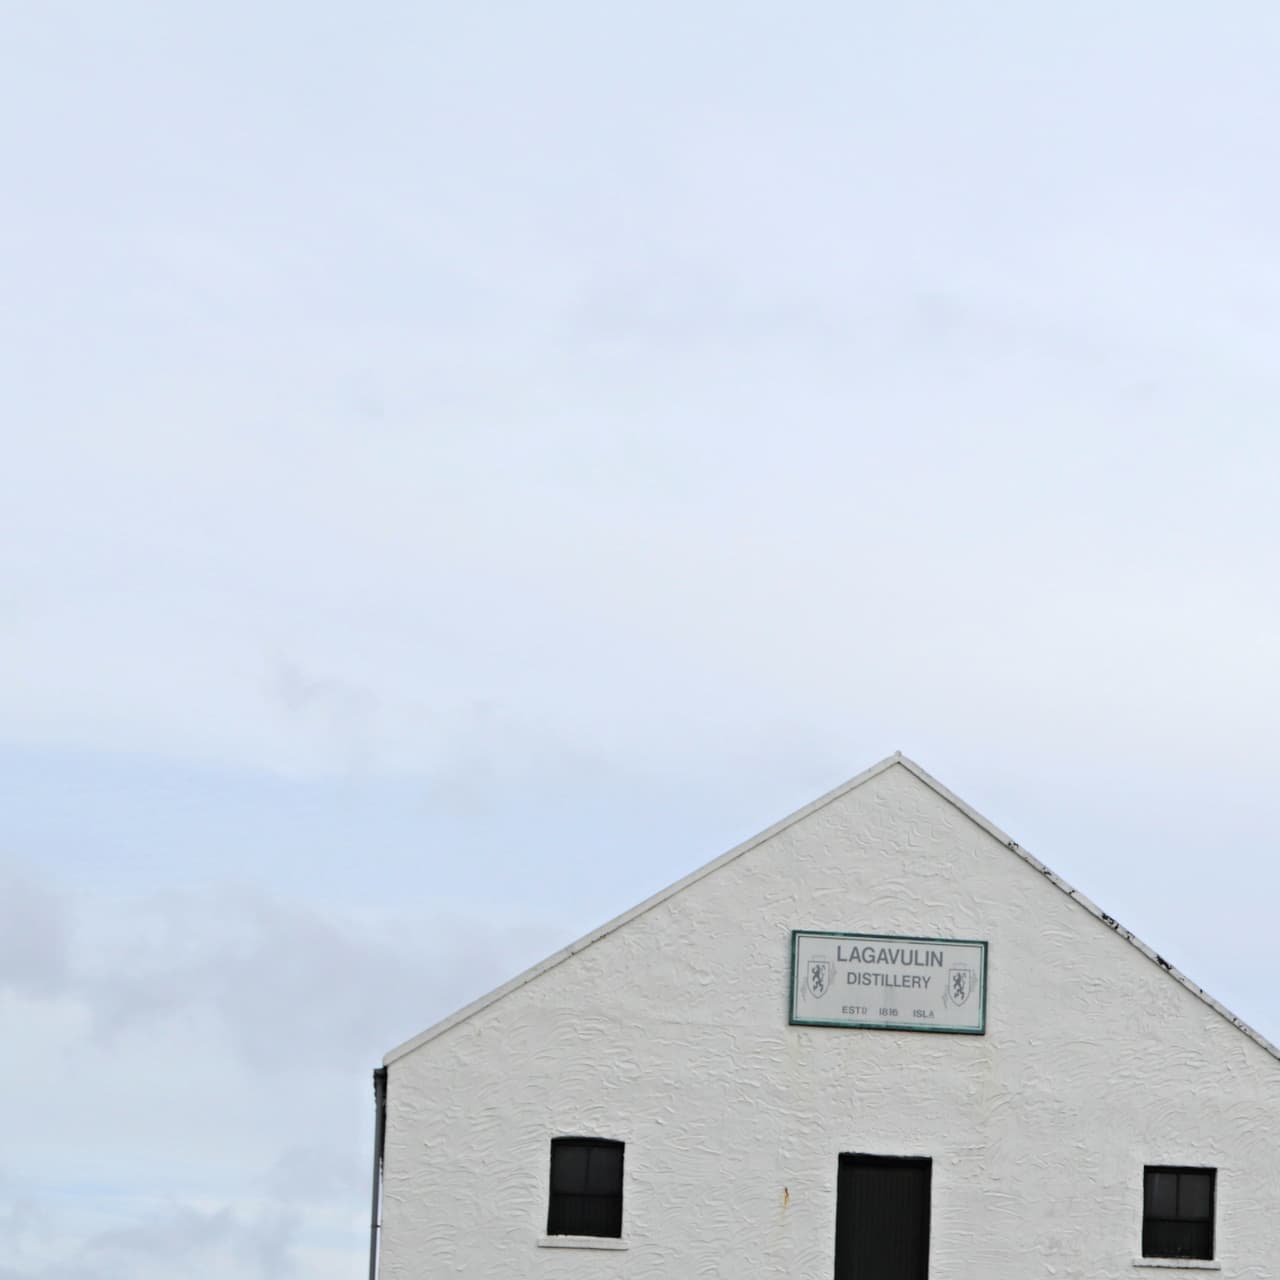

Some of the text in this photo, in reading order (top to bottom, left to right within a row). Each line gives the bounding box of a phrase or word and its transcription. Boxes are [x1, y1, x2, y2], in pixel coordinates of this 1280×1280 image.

[837, 945, 943, 967] LAGAVULIN
[847, 972, 931, 989] DISTILLERY
[878, 1007, 898, 1017] 1816
